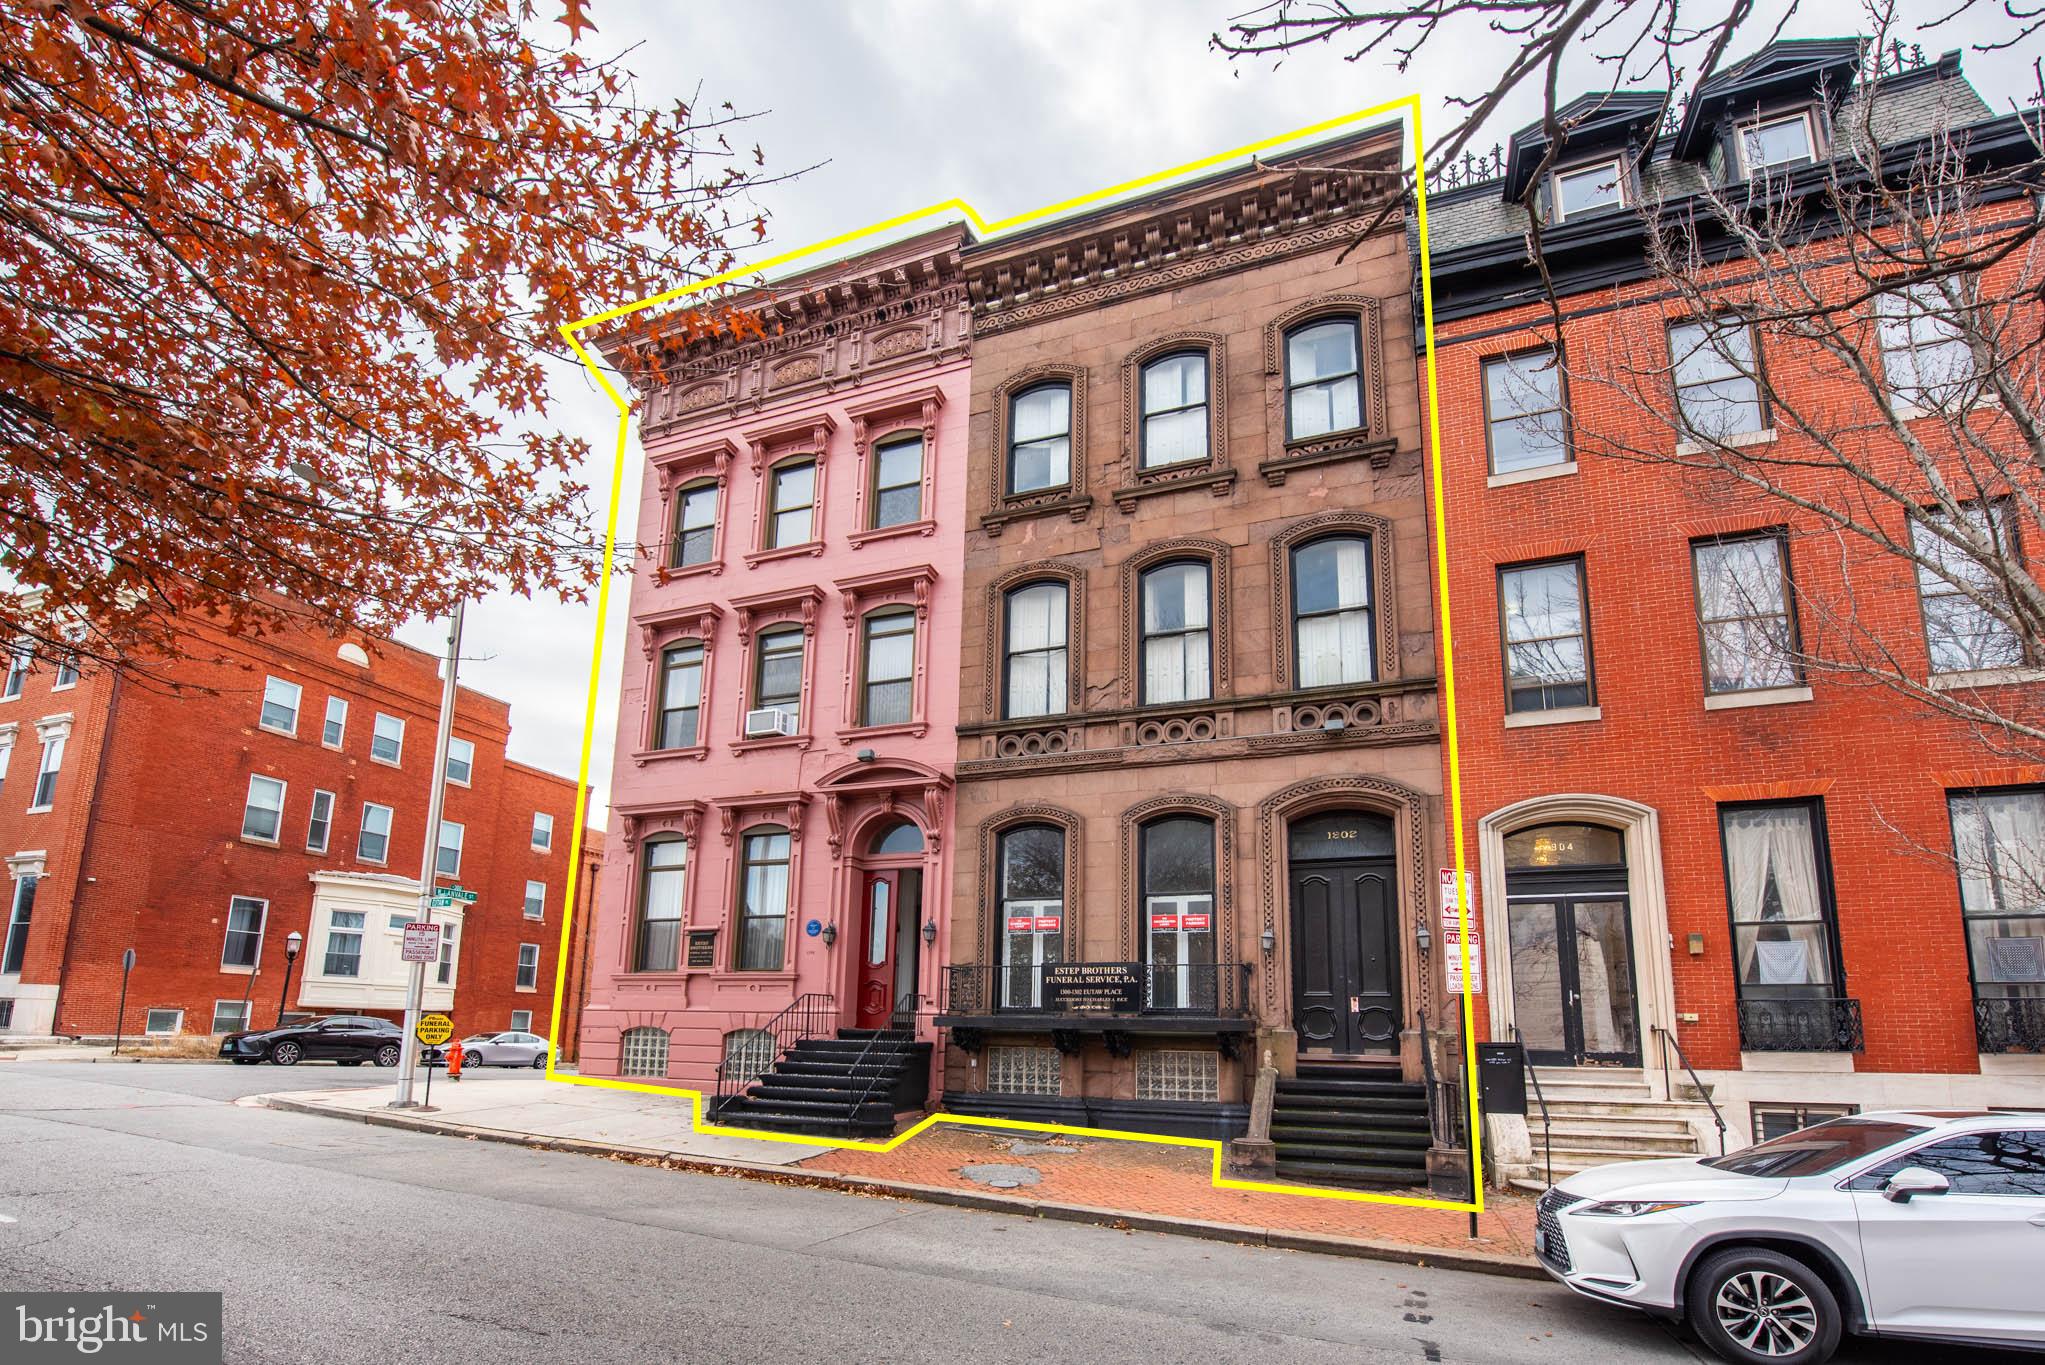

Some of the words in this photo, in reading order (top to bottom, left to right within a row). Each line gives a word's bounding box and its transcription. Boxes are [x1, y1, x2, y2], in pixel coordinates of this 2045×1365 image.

[1441, 872, 1452, 884] NO
[406, 924, 439, 932] PARKING
[1054, 967, 1080, 975] ESTEP
[1081, 966, 1128, 975] BROTHERS
[1045, 976, 1085, 984] FUNERAL
[1085, 976, 1123, 984] SERVICE,
[1123, 975, 1138, 983] P.A.
